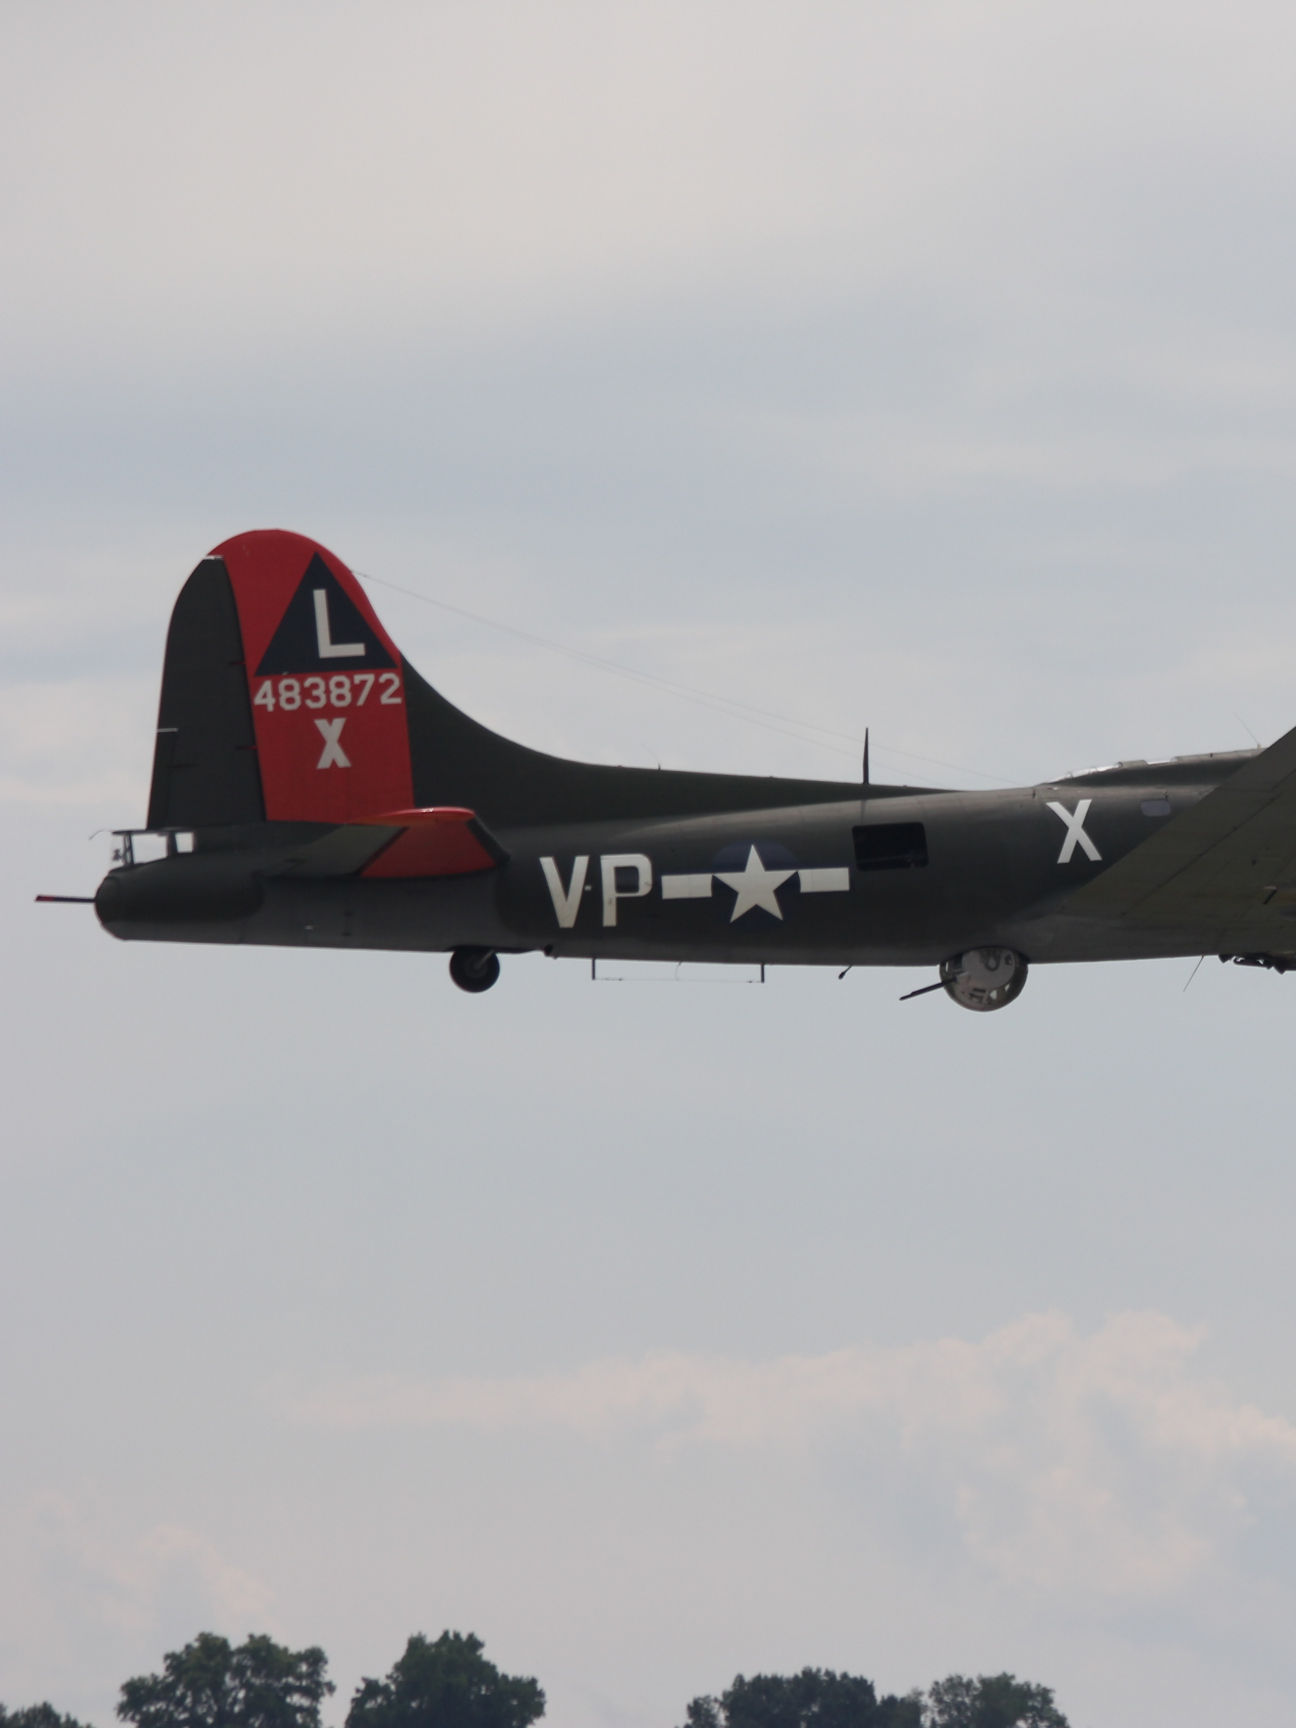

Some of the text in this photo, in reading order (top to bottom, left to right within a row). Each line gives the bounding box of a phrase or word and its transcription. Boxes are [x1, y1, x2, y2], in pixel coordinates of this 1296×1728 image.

[313, 588, 366, 658] L
[253, 672, 402, 712] 483872
[314, 717, 351, 769] X
[1046, 798, 1102, 864] X
[539, 853, 653, 928] VP
